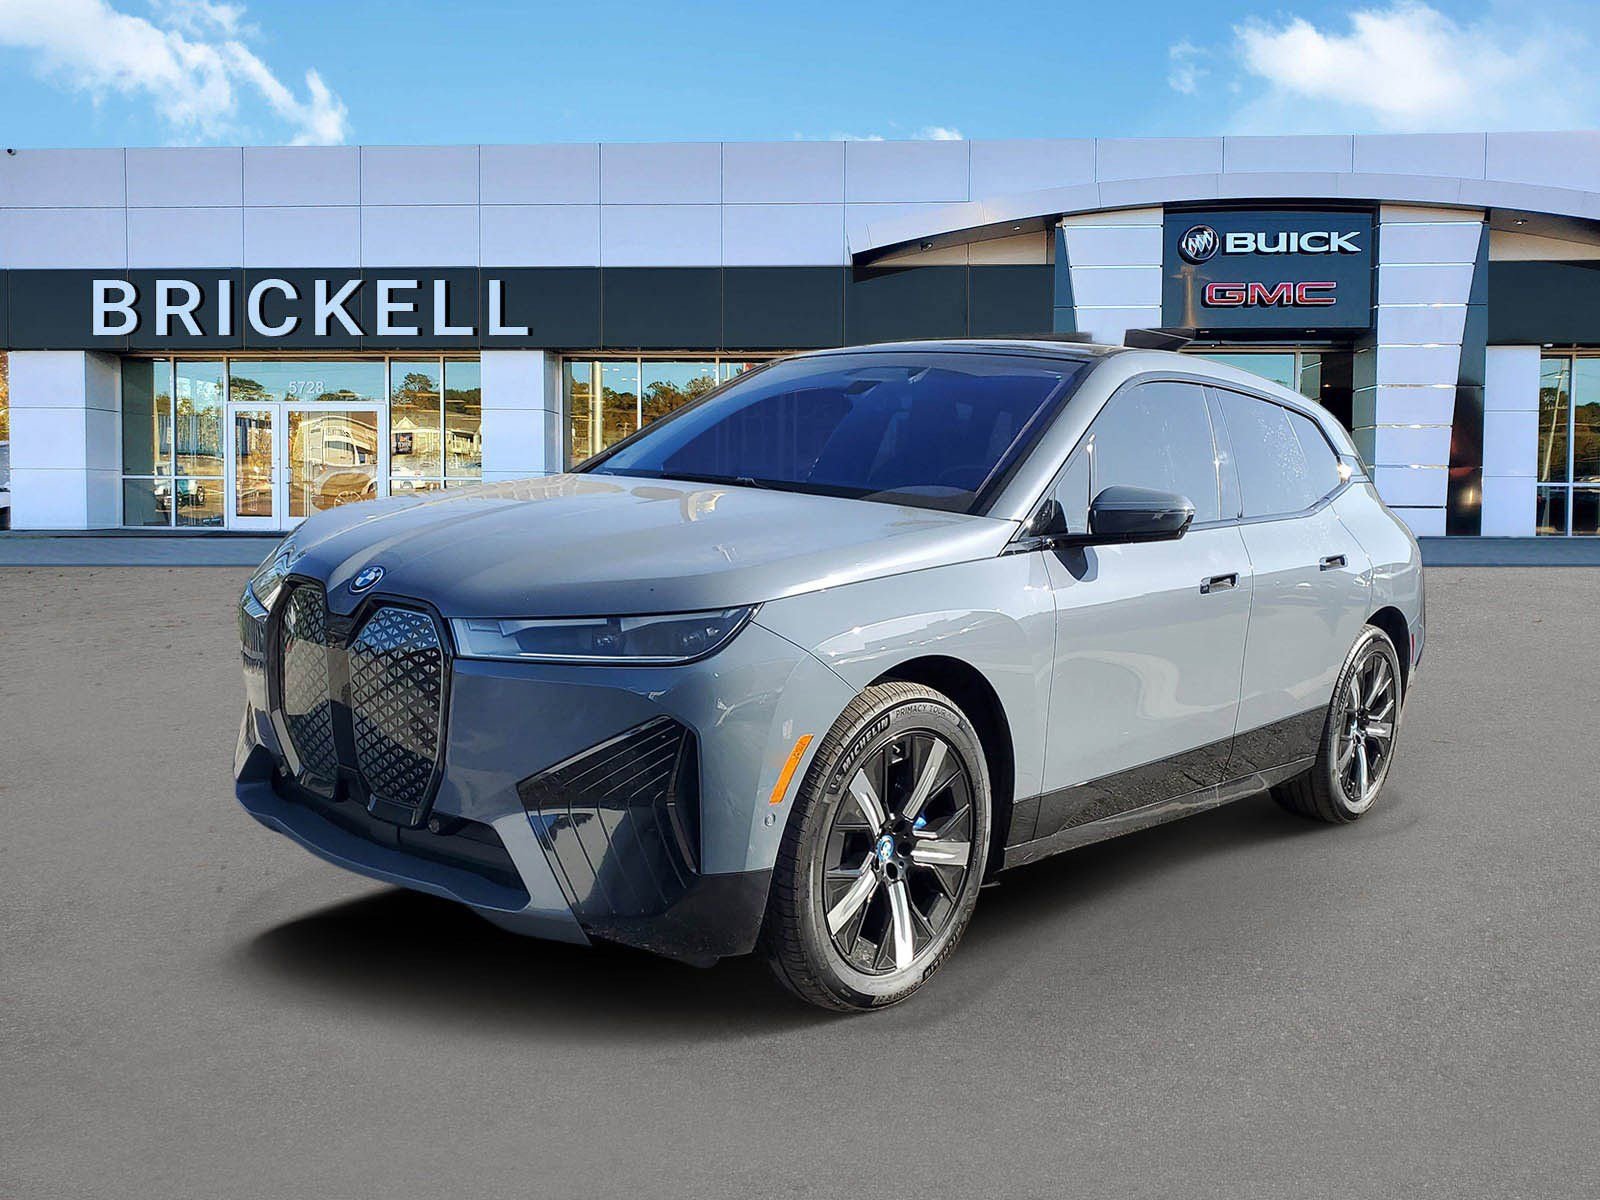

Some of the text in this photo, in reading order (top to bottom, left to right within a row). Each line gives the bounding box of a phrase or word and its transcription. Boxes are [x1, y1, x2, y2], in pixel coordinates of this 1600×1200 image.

[1225, 231, 1362, 253] BUICK
[1205, 282, 1337, 305] GMC
[92, 278, 530, 337] BRICKELL
[288, 381, 324, 395] 5728
[895, 704, 927, 719] PRIMACY
[842, 715, 889, 773] MICHELIN
